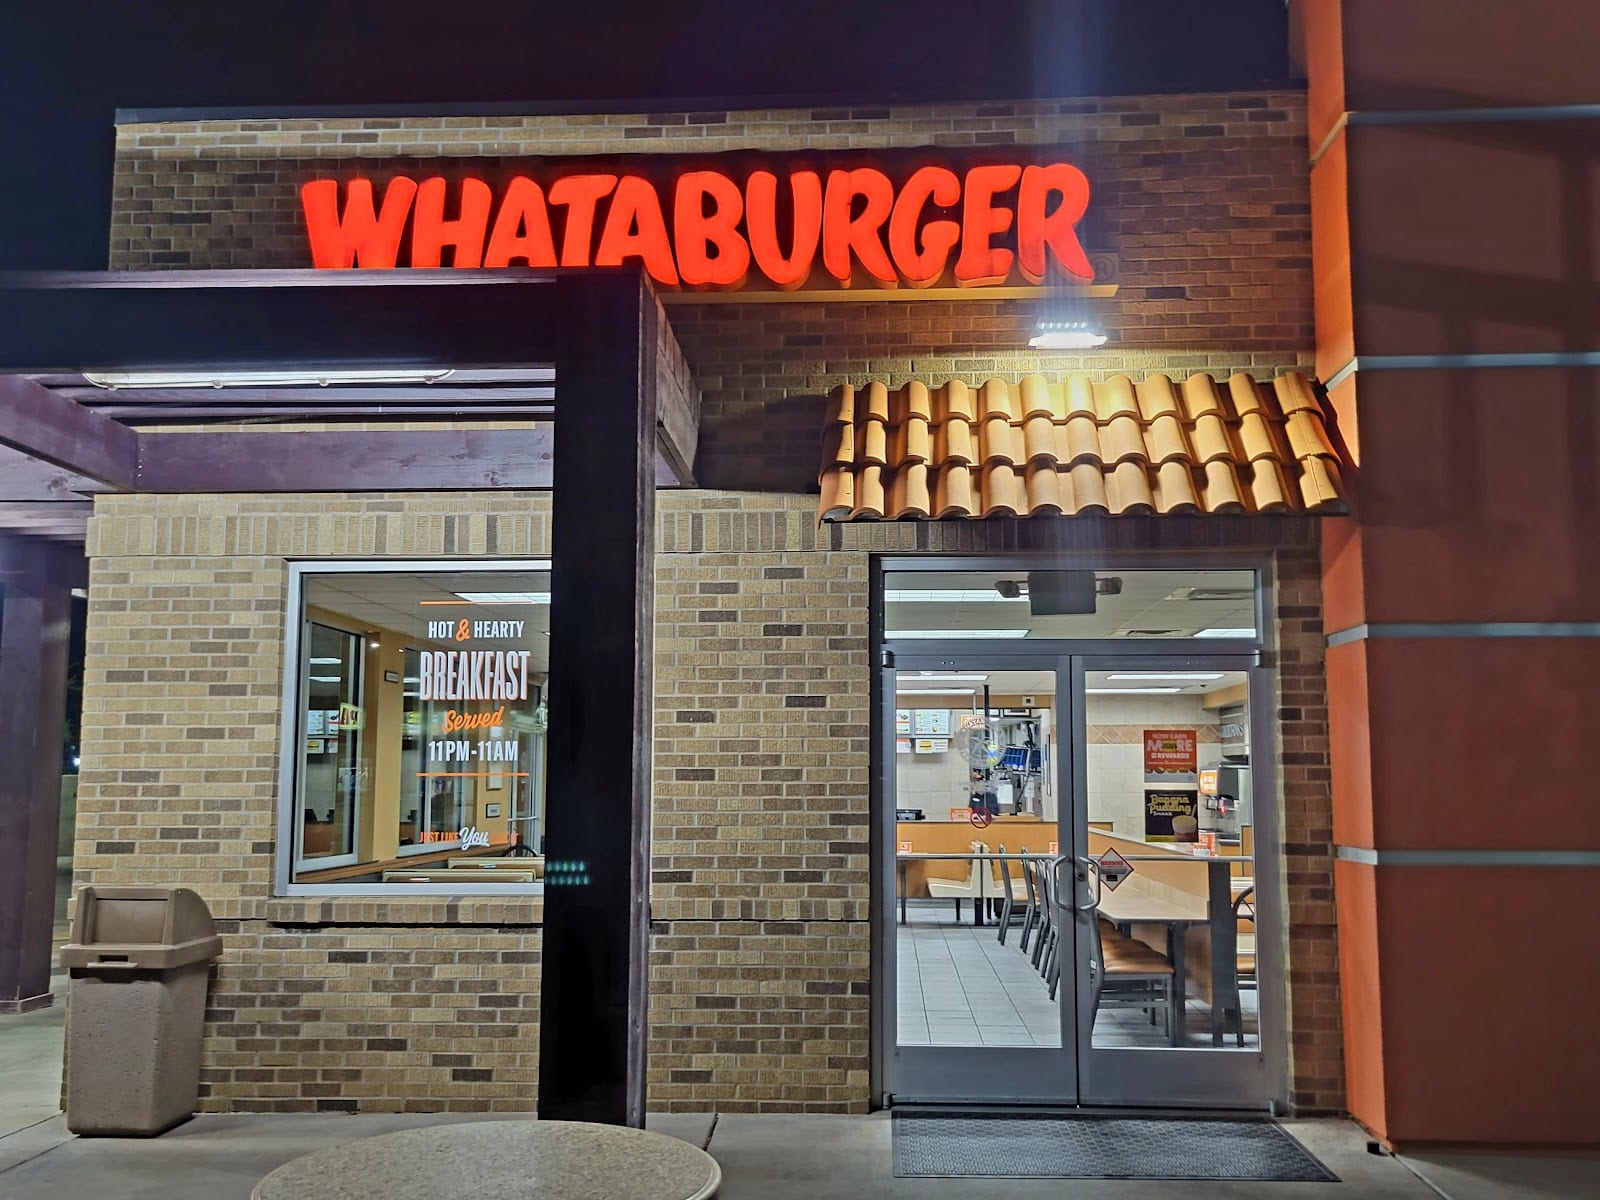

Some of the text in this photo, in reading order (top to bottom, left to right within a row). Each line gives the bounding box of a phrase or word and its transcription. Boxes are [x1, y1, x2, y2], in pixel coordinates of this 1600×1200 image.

[300, 162, 1096, 289] WHATABURGER
[428, 618, 524, 641] HOT & HEARTY
[420, 651, 531, 700] BREAKFAST
[442, 706, 504, 733] Served
[429, 741, 518, 761] 11PM-11AM
[1147, 739, 1193, 752] MRE
[459, 827, 490, 850] You
